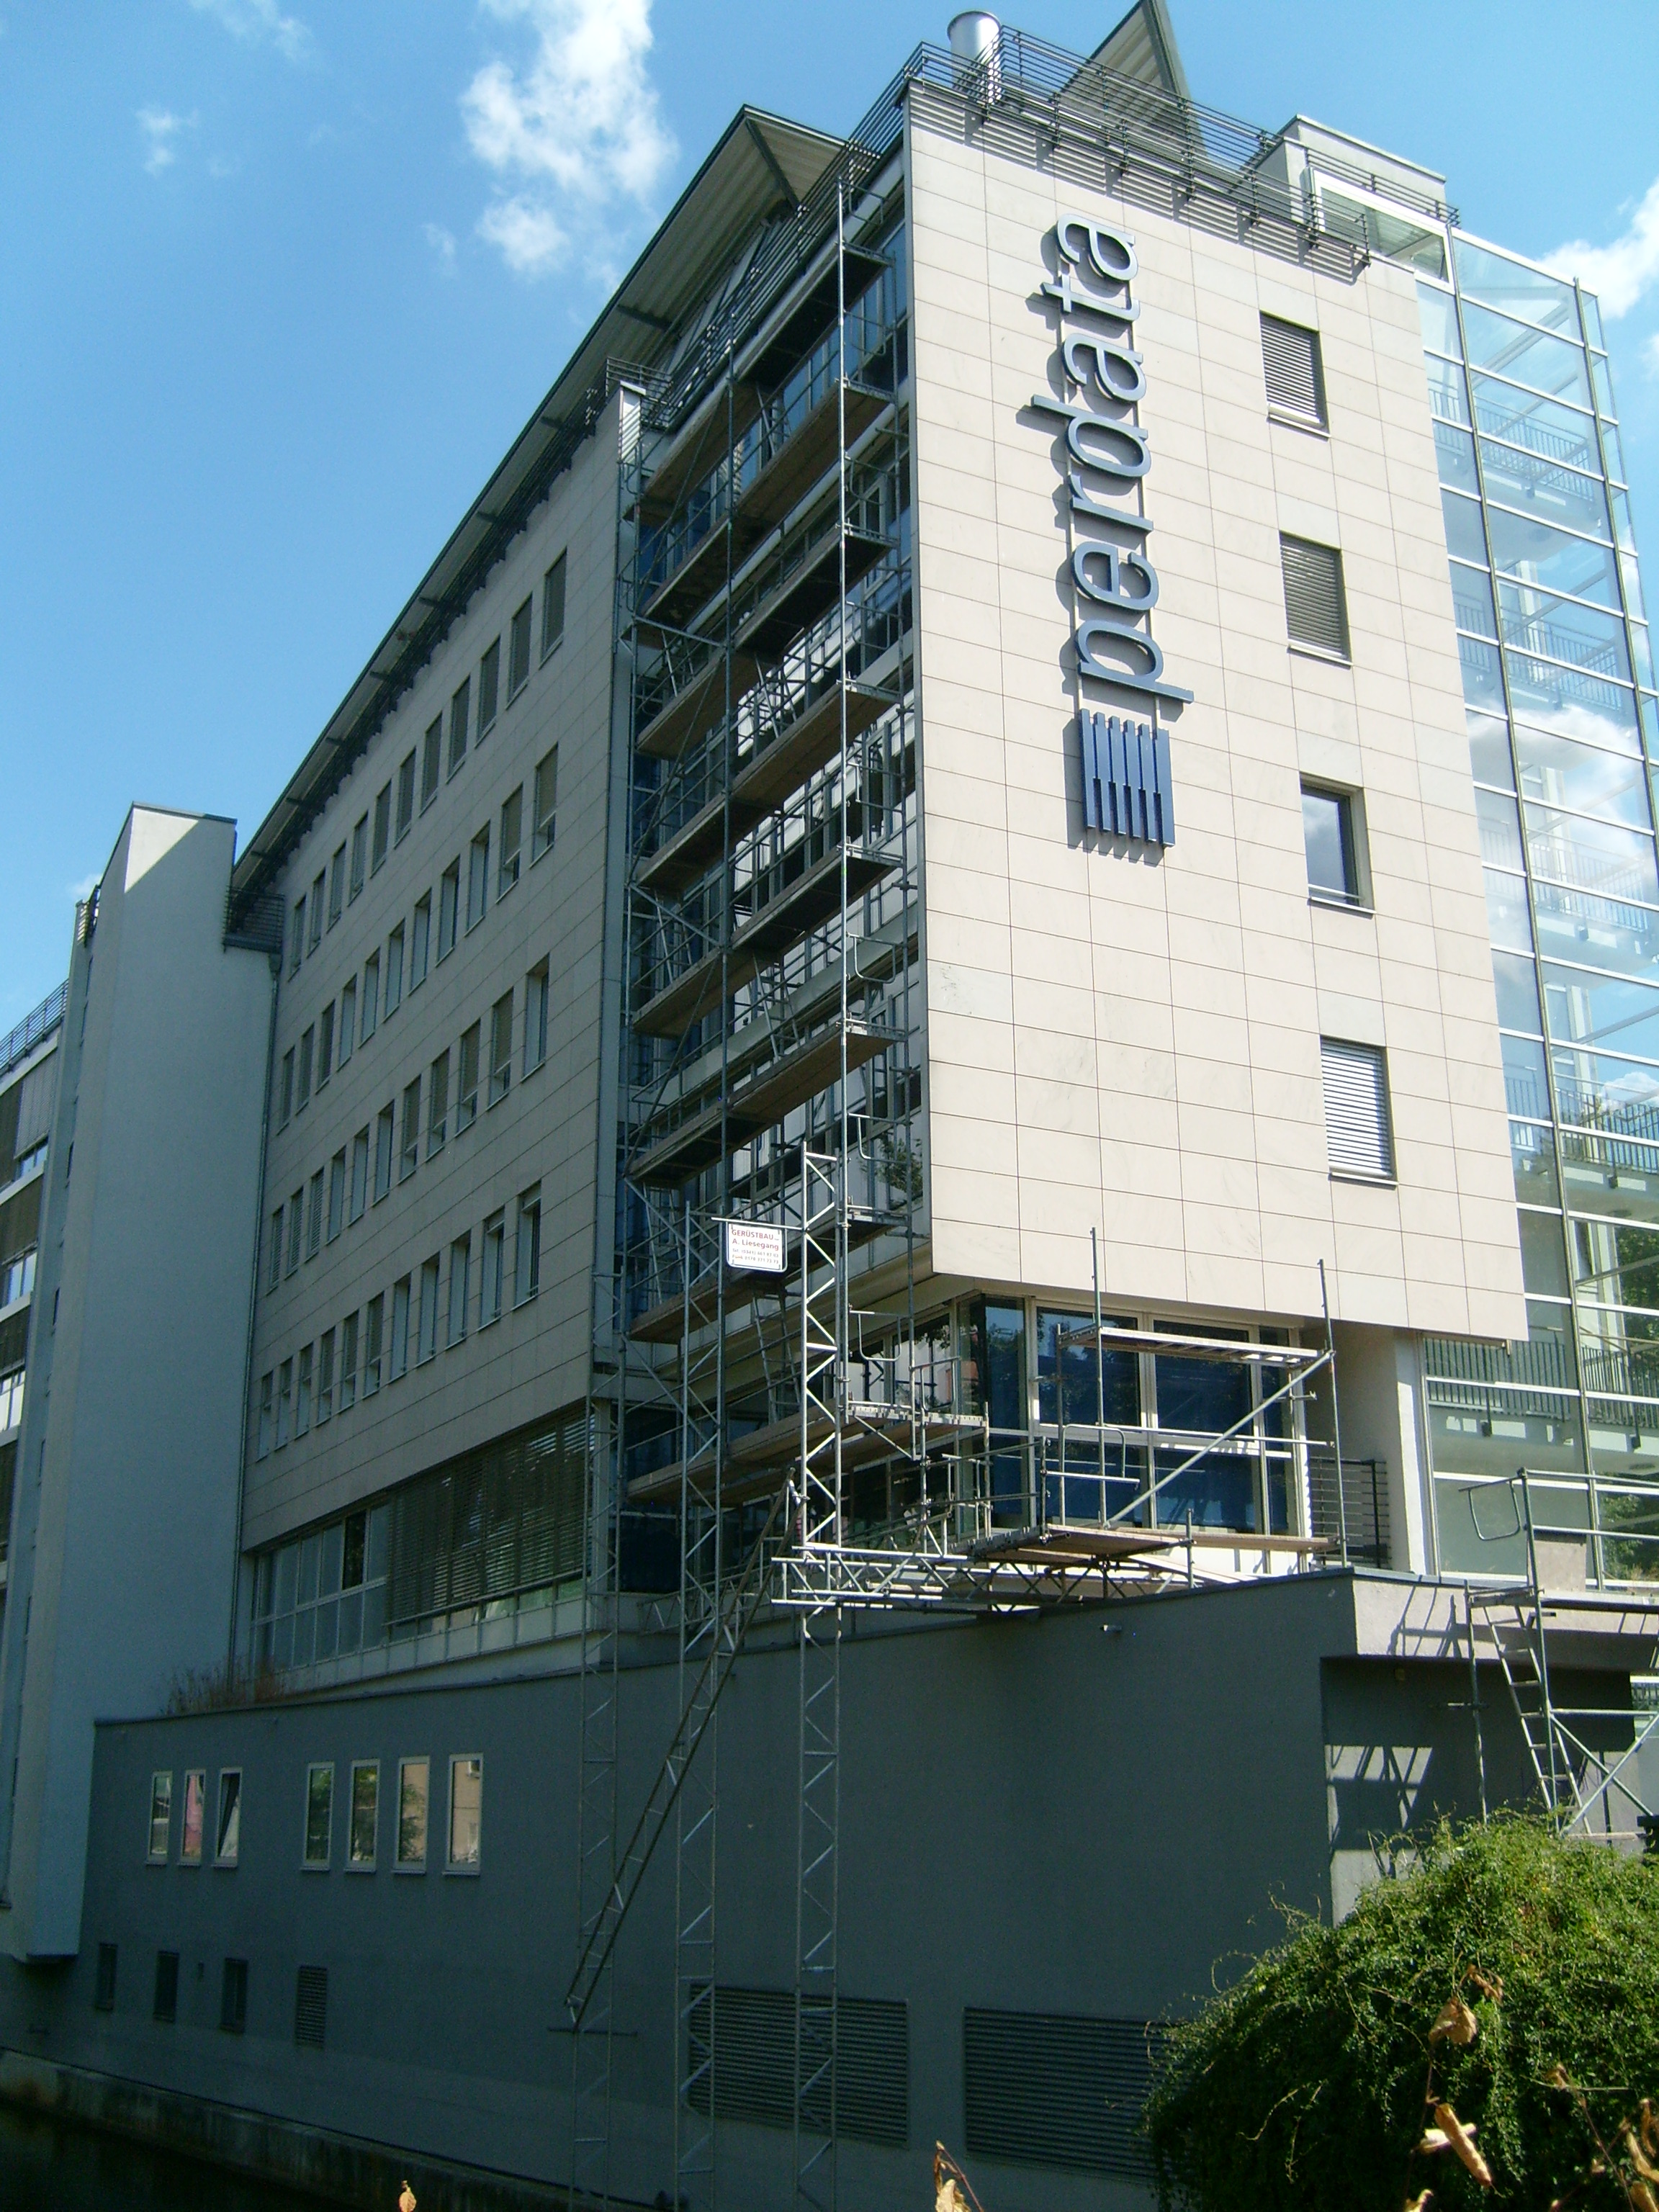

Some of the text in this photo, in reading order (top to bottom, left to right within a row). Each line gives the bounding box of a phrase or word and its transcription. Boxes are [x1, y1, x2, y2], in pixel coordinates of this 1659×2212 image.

[1030, 213, 1194, 704] perdata
[732, 1229, 773, 1240] GERÜSTBAU
[742, 1239, 778, 1251] Liesegang
